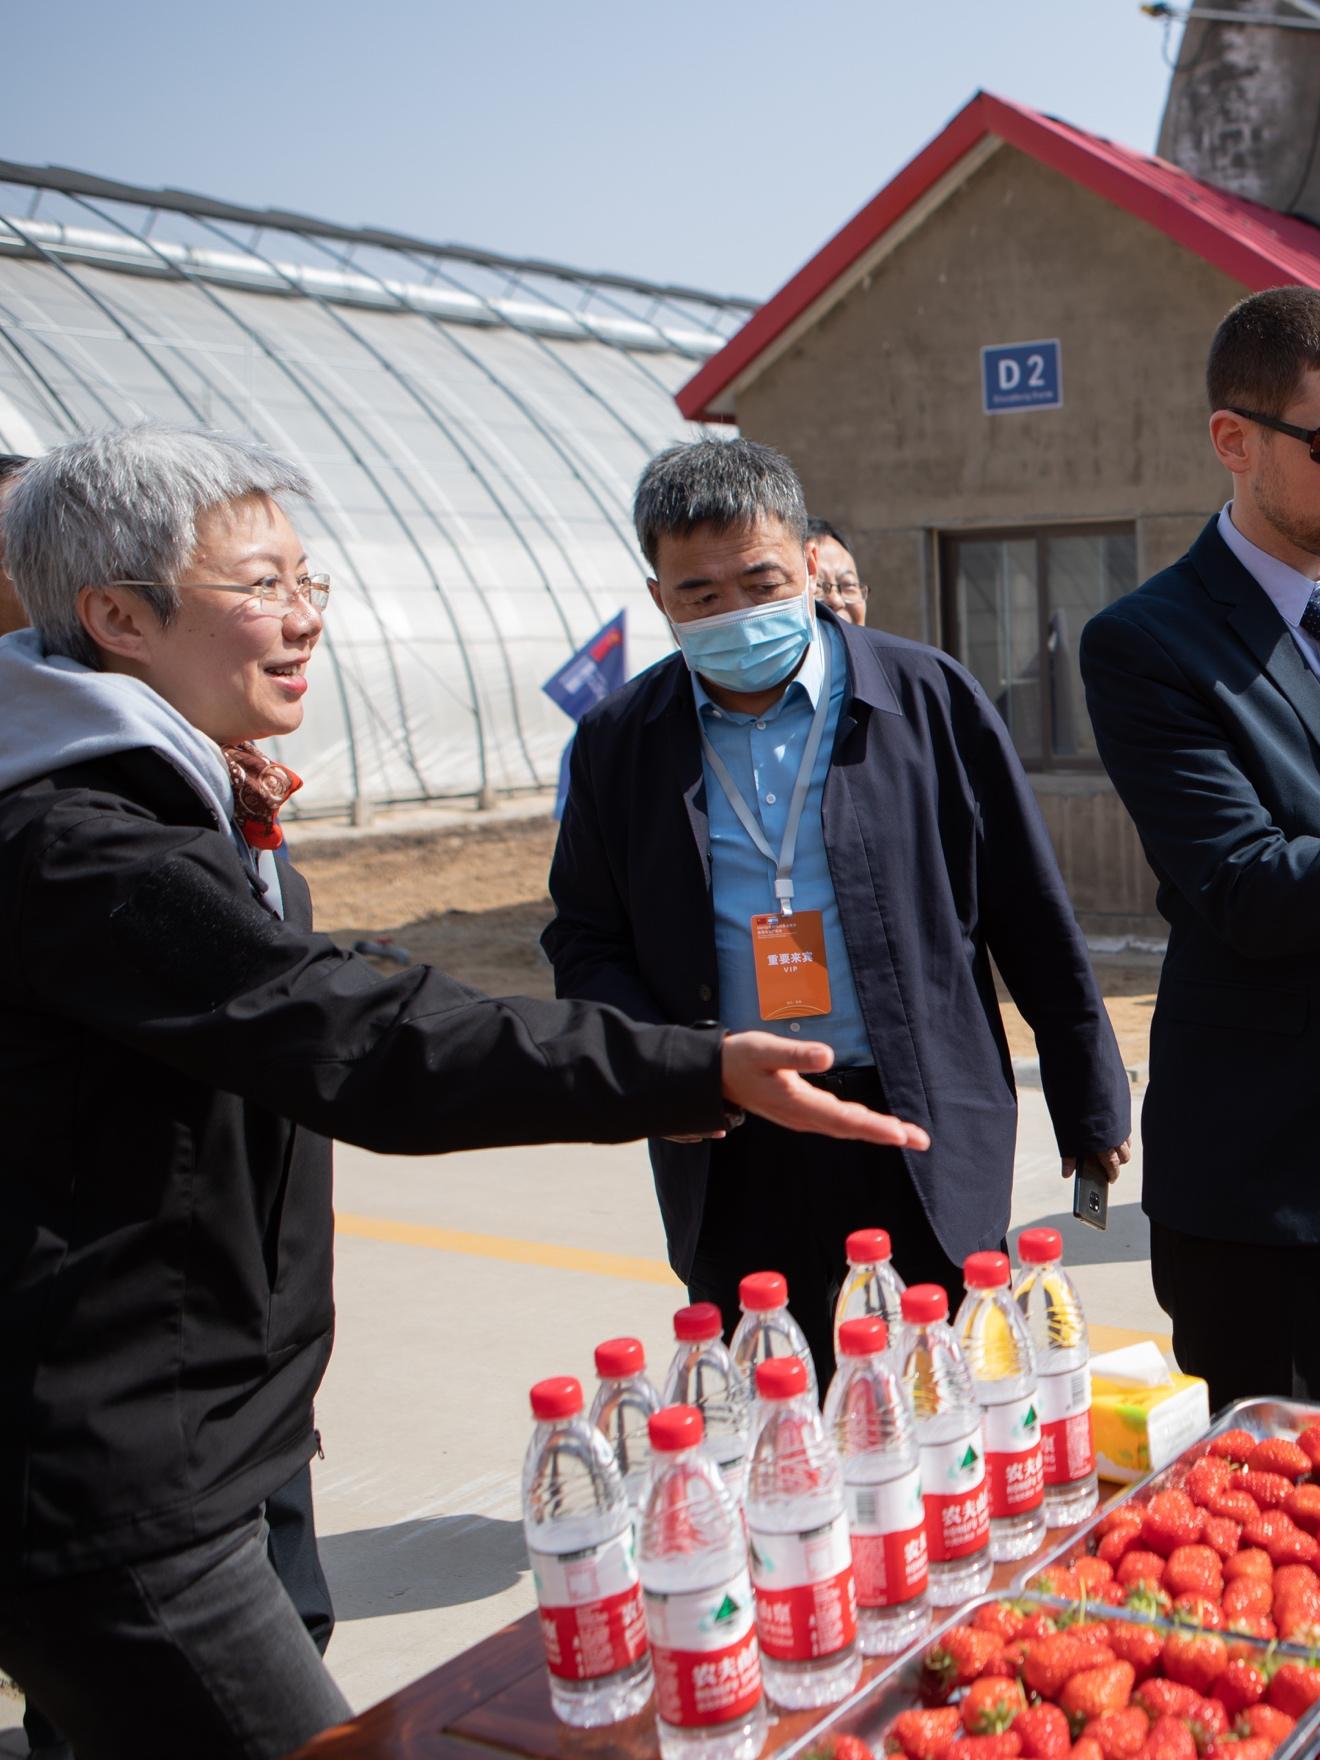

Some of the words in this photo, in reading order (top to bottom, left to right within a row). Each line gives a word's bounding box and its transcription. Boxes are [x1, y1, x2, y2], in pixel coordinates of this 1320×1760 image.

[998, 354, 1045, 390] D2
[768, 952, 813, 965] 重要来宾
